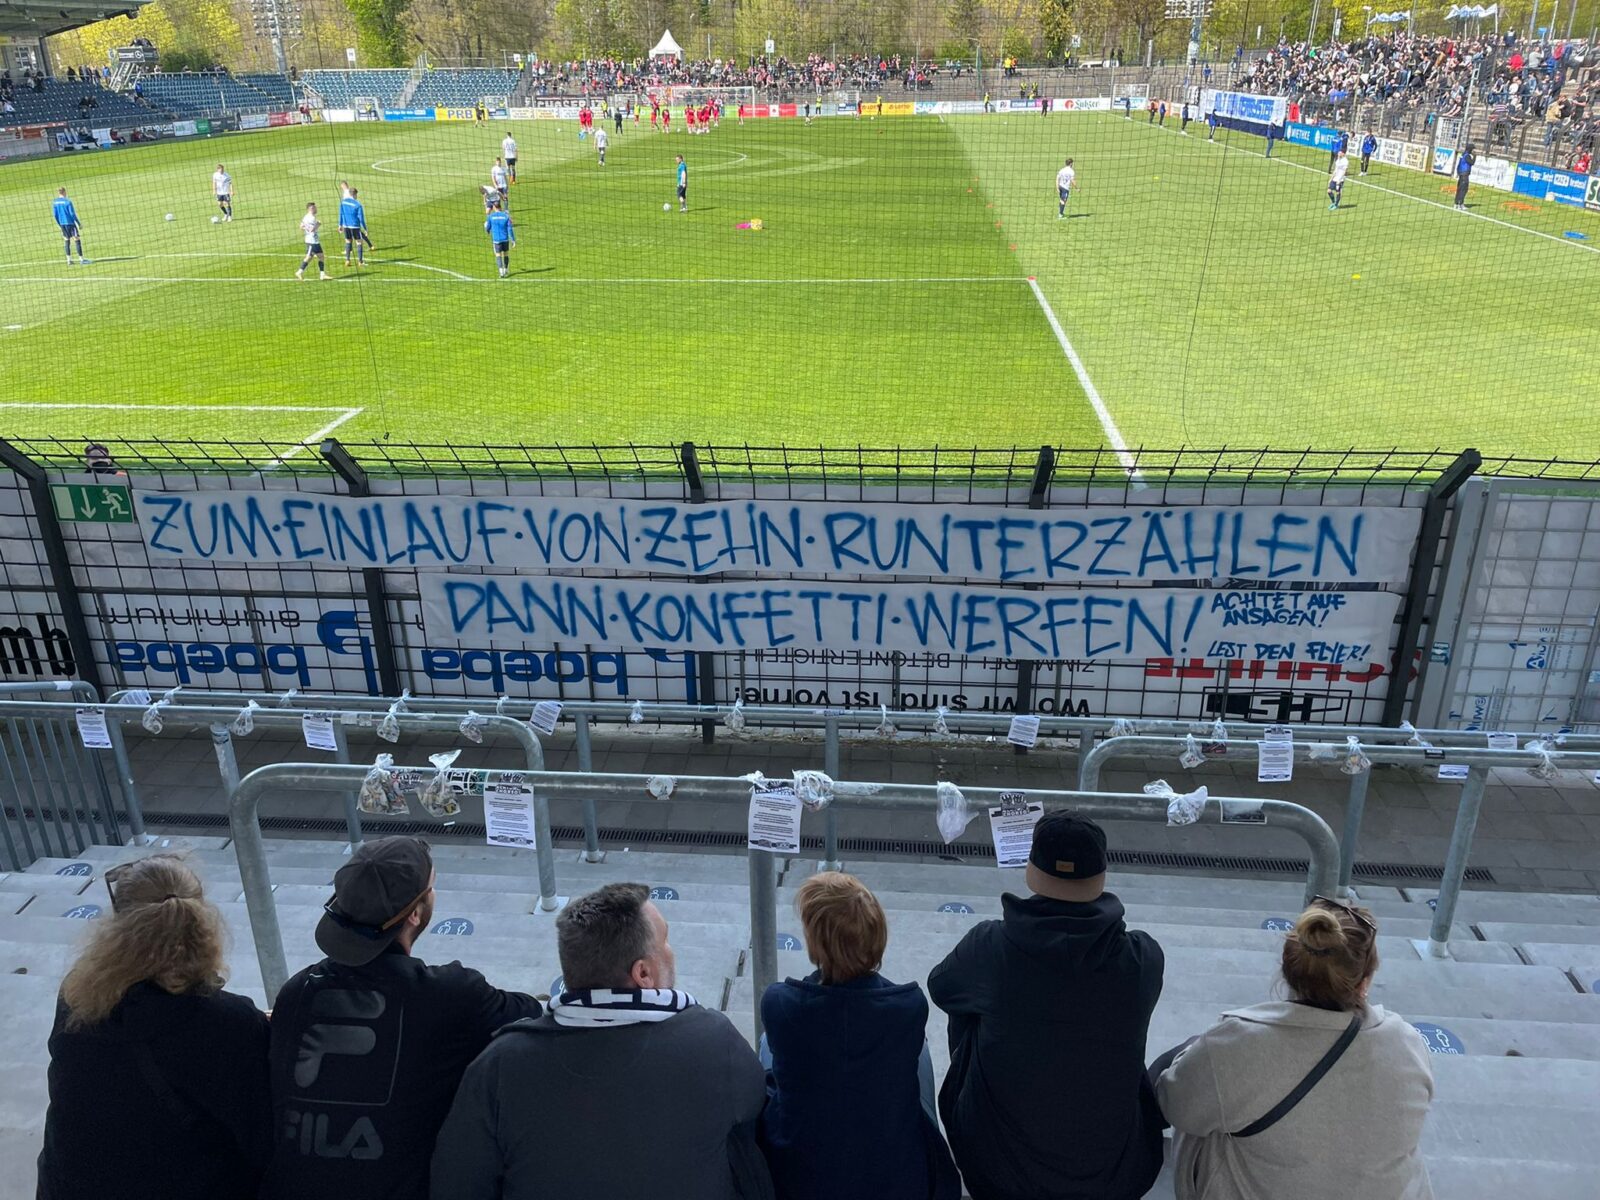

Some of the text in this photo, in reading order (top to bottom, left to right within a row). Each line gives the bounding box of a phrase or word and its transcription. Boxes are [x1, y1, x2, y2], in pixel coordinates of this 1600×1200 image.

[447, 109, 474, 120] PRB
[143, 496, 1365, 580] ZUM EINLAUF VON ZEHN RUNTERZÄHLEN
[1211, 591, 1347, 613] ACHTET AUF
[98, 606, 301, 635] aluminium
[444, 580, 1205, 658] DANN KONFETTI WERFEN!
[1222, 607, 1329, 628] ANSAGEN!
[107, 641, 312, 687] boeba
[982, 654, 1095, 673] ZIMMREI
[1206, 640, 1372, 664] LEST DEN FLYER!
[421, 648, 630, 696] boeba
[284, 1110, 384, 1160] FILA
